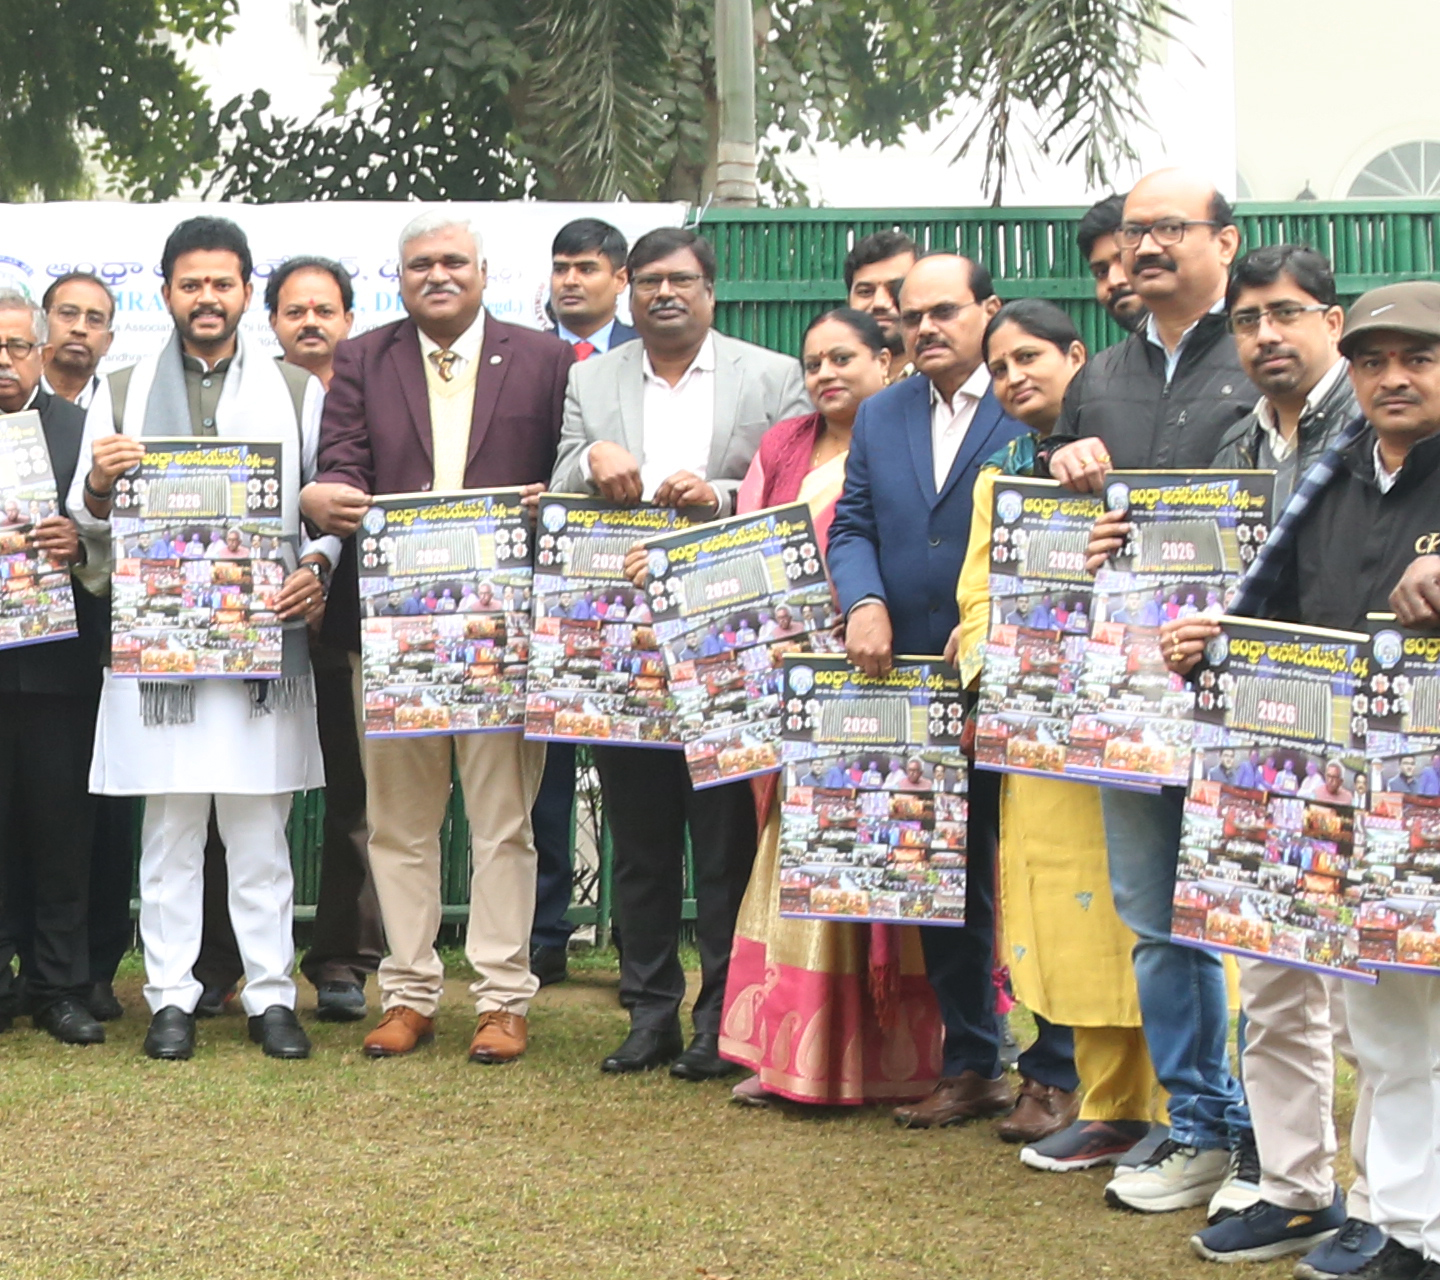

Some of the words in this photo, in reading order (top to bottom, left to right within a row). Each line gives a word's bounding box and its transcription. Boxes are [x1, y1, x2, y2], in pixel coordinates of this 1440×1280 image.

[1048, 550, 1085, 570] 2026
[1161, 541, 1196, 561] 2026
[1258, 700, 1297, 724] 2026
[843, 716, 879, 734] 2026
